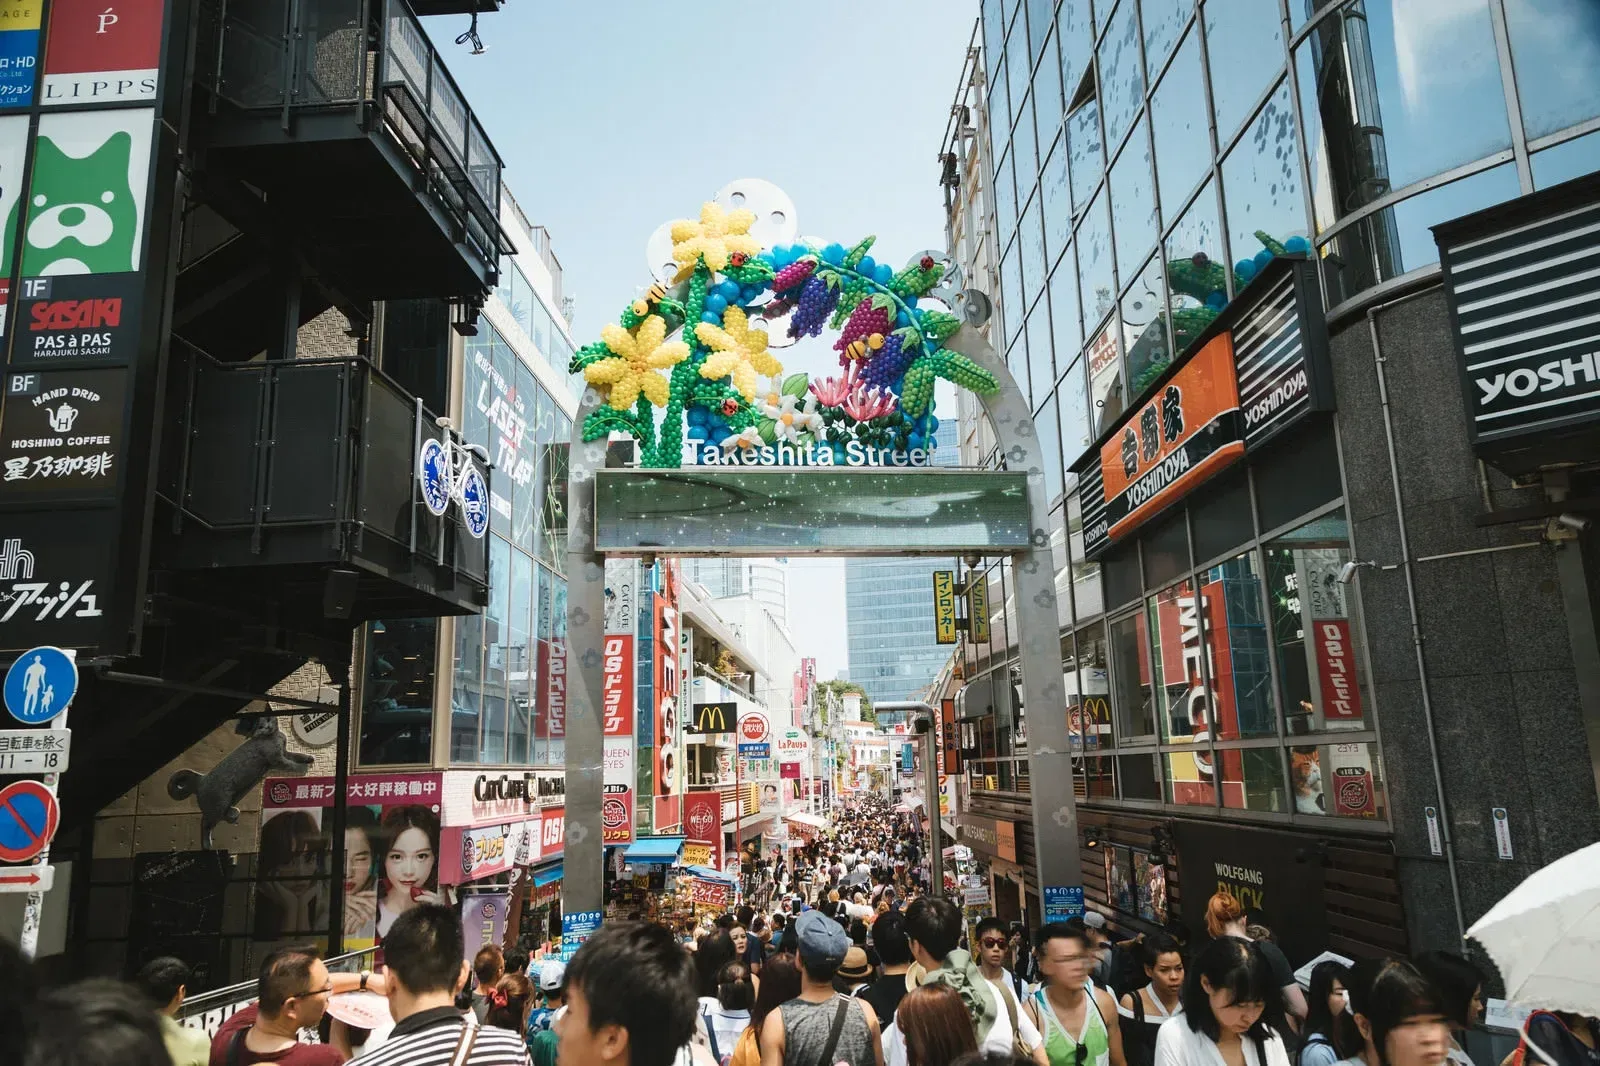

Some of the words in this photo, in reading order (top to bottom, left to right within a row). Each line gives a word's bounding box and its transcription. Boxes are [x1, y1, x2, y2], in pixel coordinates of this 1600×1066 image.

[46, 78, 156, 99] LIPPS
[25, 280, 47, 297] 1F
[35, 335, 64, 349] PAS
[68, 334, 78, 348] à
[81, 332, 112, 347] PAS
[34, 349, 78, 358] HARAJUKU
[80, 347, 110, 356] SASAKI
[12, 375, 34, 392] BF
[32, 388, 68, 407] HAND
[72, 387, 101, 402] DRIP
[477, 380, 526, 448] LASER
[11, 437, 63, 449] HOSHINO
[67, 435, 111, 447] COFFEE
[687, 438, 834, 466] Takeshita
[846, 440, 938, 466] Street
[3, 451, 114, 482] 星乃珈琲
[495, 436, 534, 488] TRAP
[1126, 446, 1190, 511] YOSHINOYA
[0, 579, 103, 622] アッシュ
[938, 571, 953, 634] コインロッカー
[603, 639, 625, 733] OSドラッグ
[0, 735, 64, 750] 自転車を除く
[778, 740, 787, 749] La
[787, 739, 807, 749] Pausa
[0, 753, 15, 768] 11
[44, 753, 58, 768] 18
[1215, 862, 1263, 885] WOLFGANG
